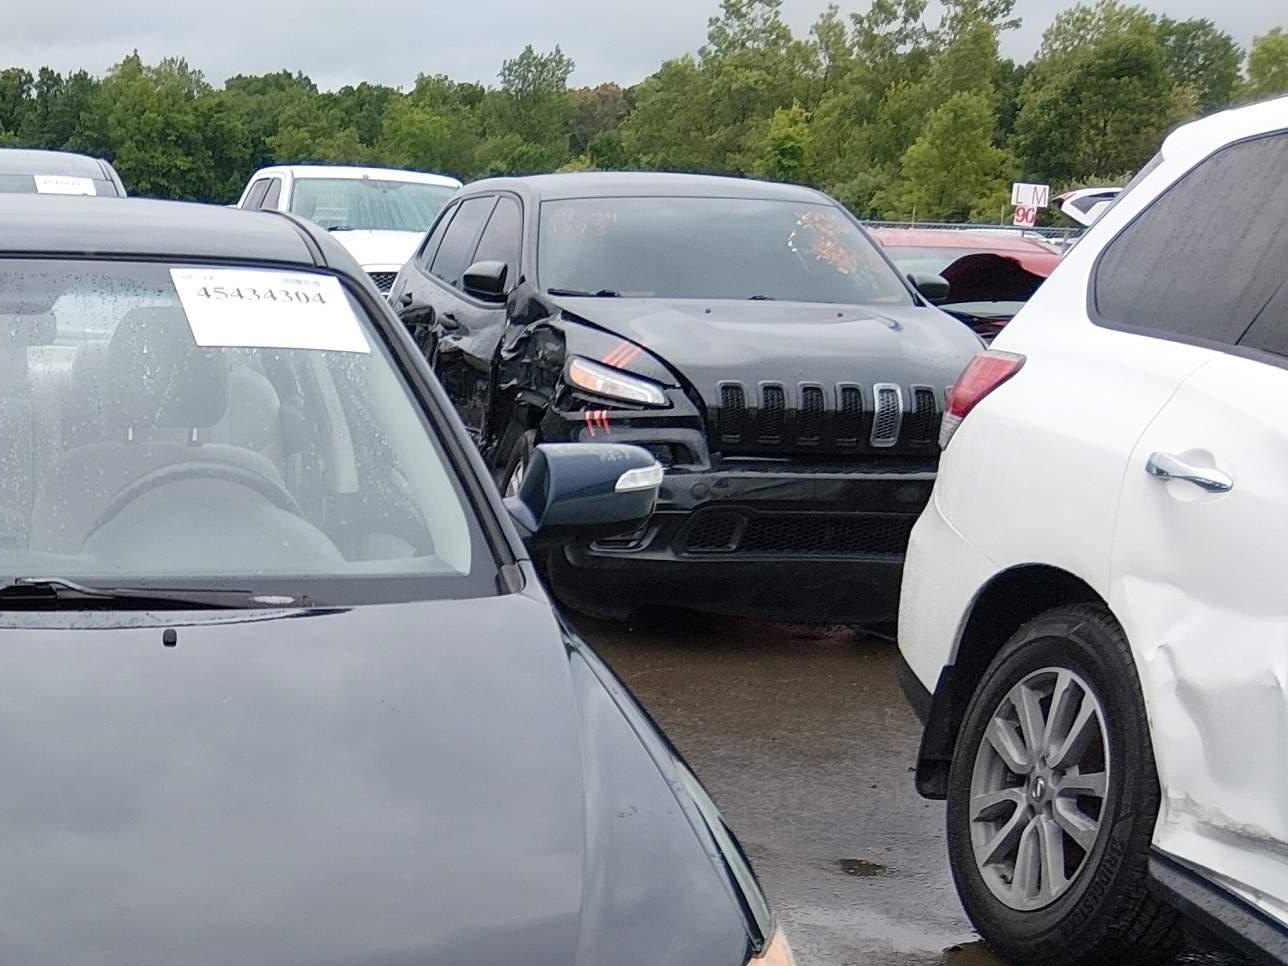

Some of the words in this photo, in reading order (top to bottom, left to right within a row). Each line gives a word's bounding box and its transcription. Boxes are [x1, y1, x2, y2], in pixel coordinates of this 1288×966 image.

[1015, 185, 1023, 204] L
[1032, 186, 1047, 206] M
[1015, 207, 1035, 223] 90
[196, 286, 327, 304] 45434304
